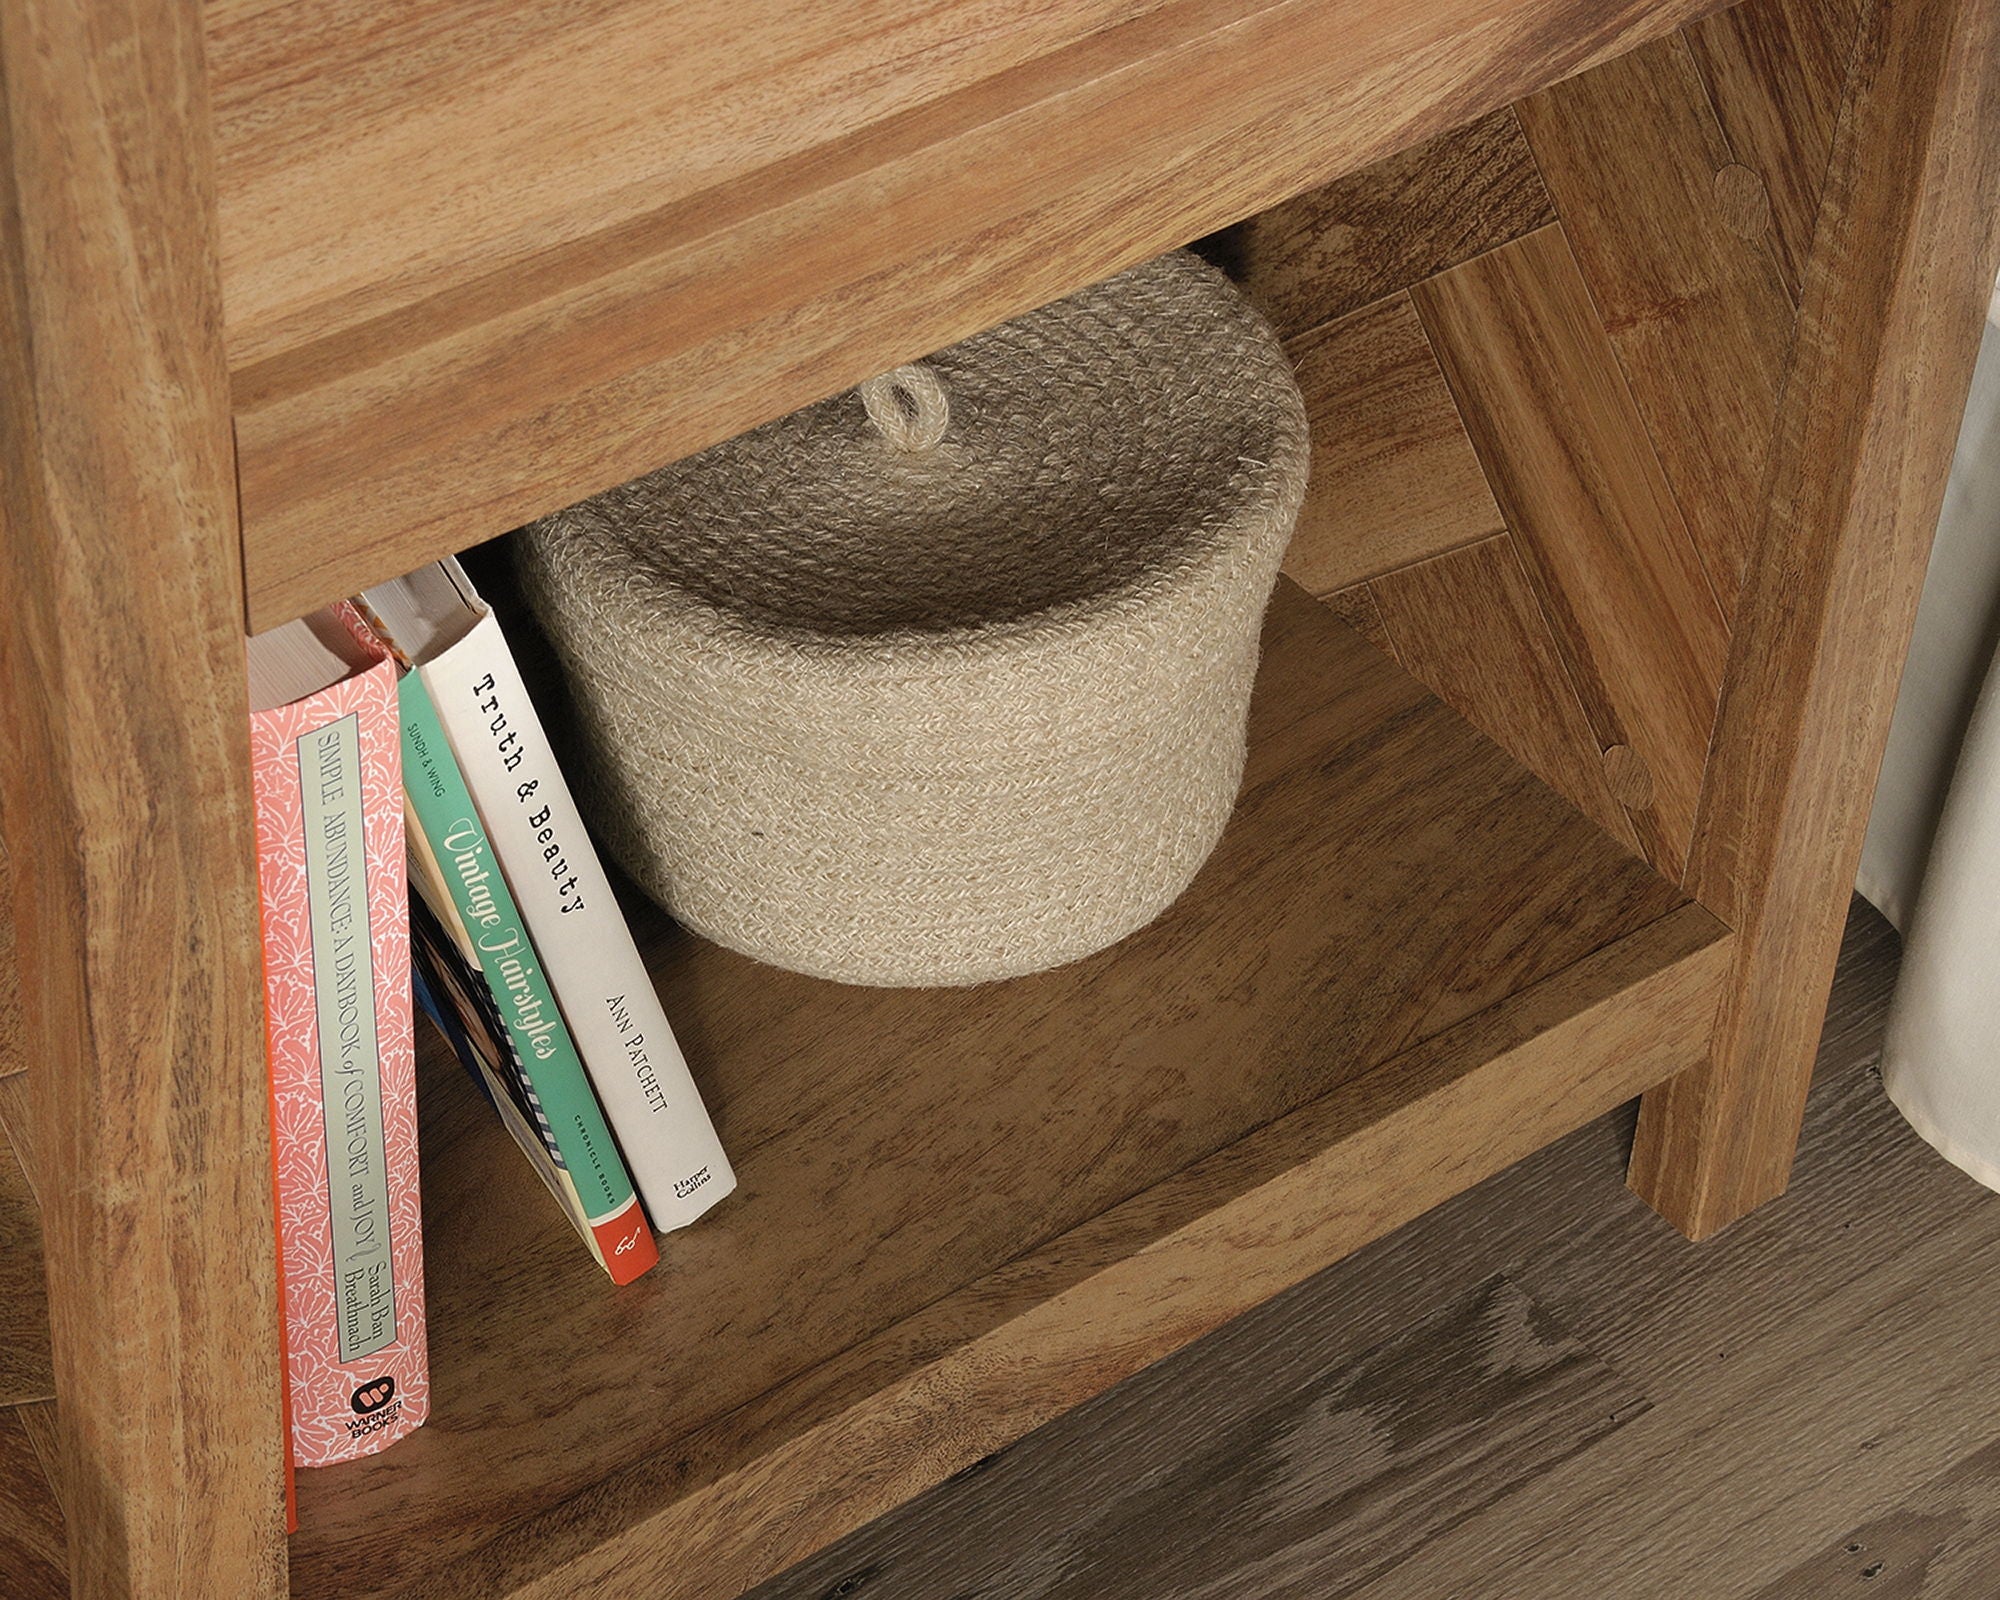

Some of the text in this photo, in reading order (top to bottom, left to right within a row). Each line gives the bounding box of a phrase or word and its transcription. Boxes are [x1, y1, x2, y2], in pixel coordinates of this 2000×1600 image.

[407, 722, 446, 799] SUNDH & WING
[473, 672, 585, 915] Truth & Beauty
[443, 817, 557, 1061] Vintage Hairstyles
[318, 731, 375, 1246] SIMPLE ABUNDANCE: A DAYBOOK of COMFORT and JOY
[606, 993, 668, 1114] ANN PATCHETT
[574, 1114, 617, 1205] CHRONICLE BOOKS
[672, 1165, 710, 1192] Harper
[676, 1174, 712, 1200] Collins
[344, 1267, 372, 1352] Breathnach
[368, 1260, 391, 1341] Sarah Ban
[345, 1400, 402, 1430] WARNER
[351, 1412, 399, 1440] BOOKS
